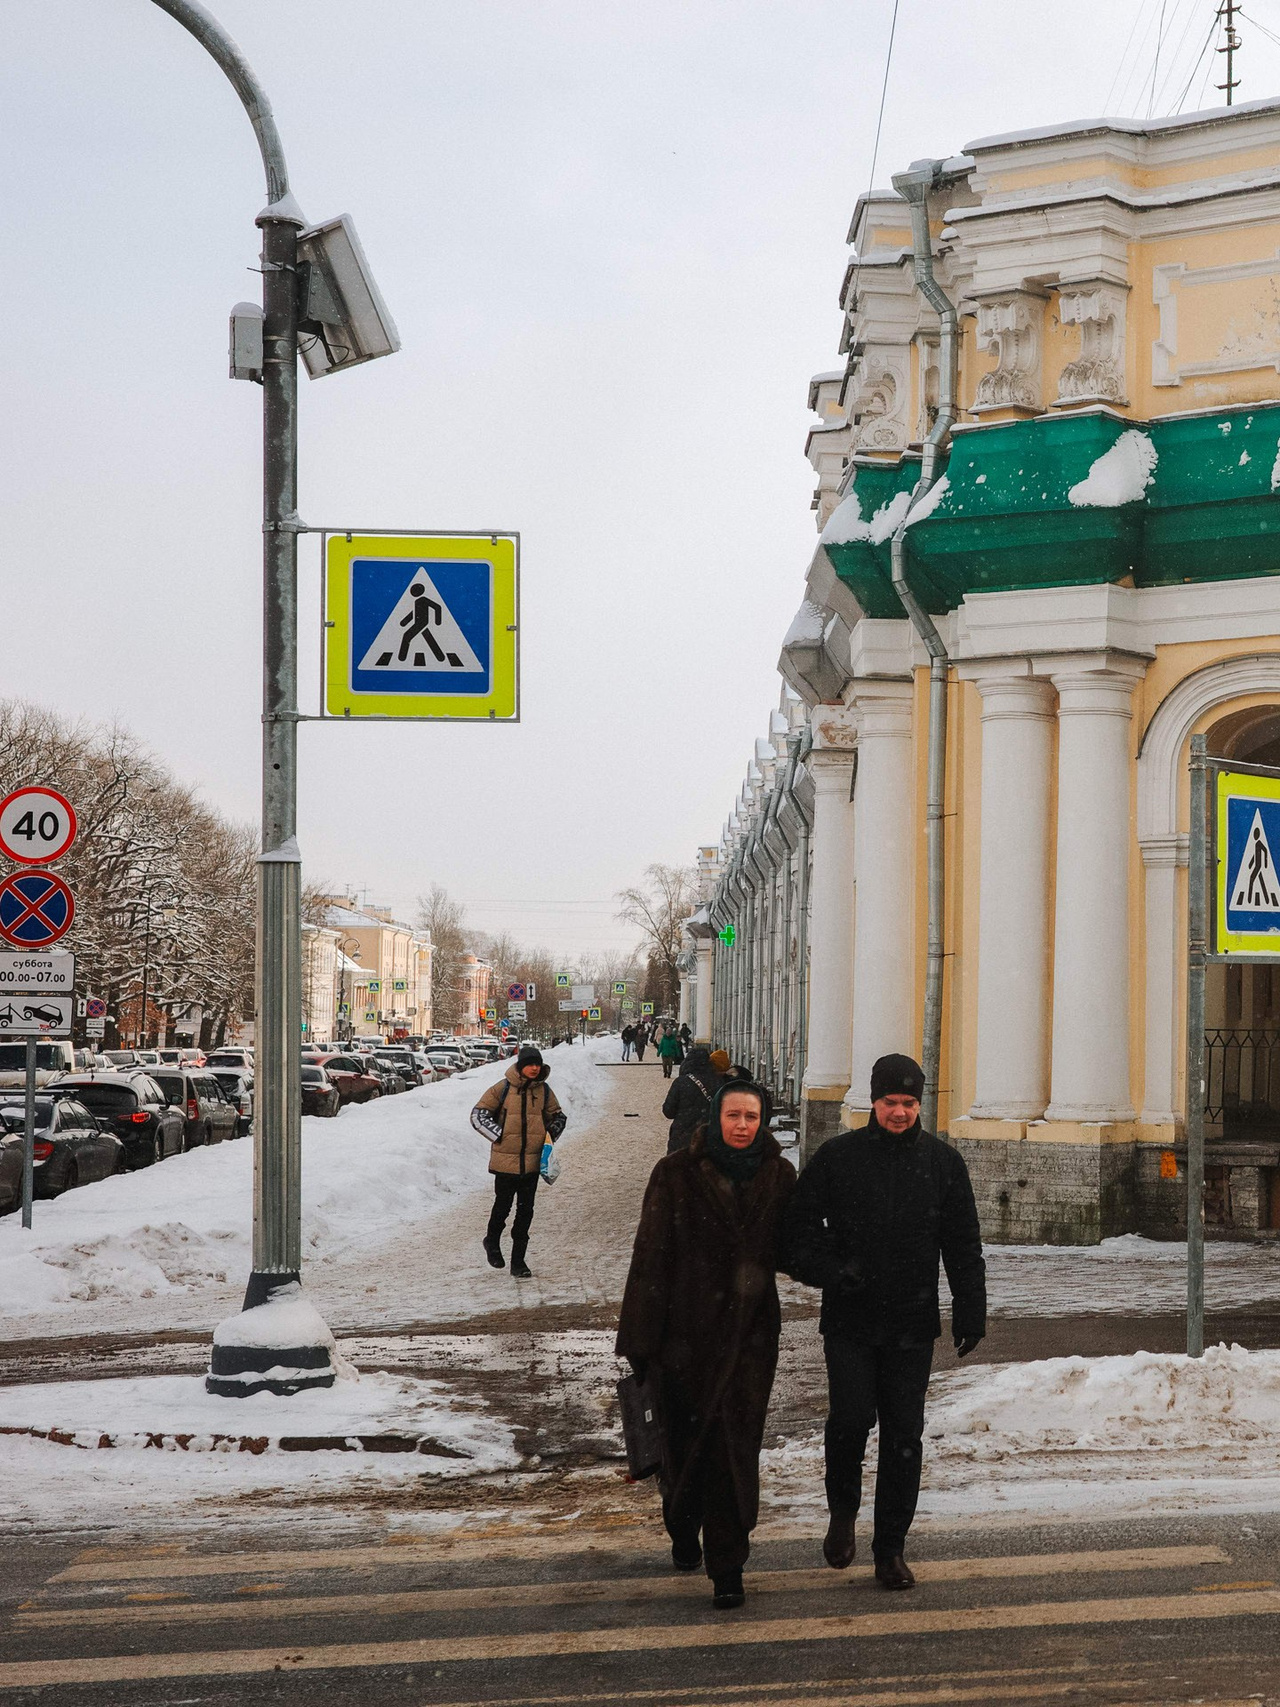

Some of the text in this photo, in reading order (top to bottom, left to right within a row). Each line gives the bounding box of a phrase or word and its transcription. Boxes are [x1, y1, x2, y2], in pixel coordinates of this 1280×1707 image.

[12, 811, 59, 841] 40
[13, 960, 53, 969] суббота
[0, 971, 65, 983] 00.00-07.00
